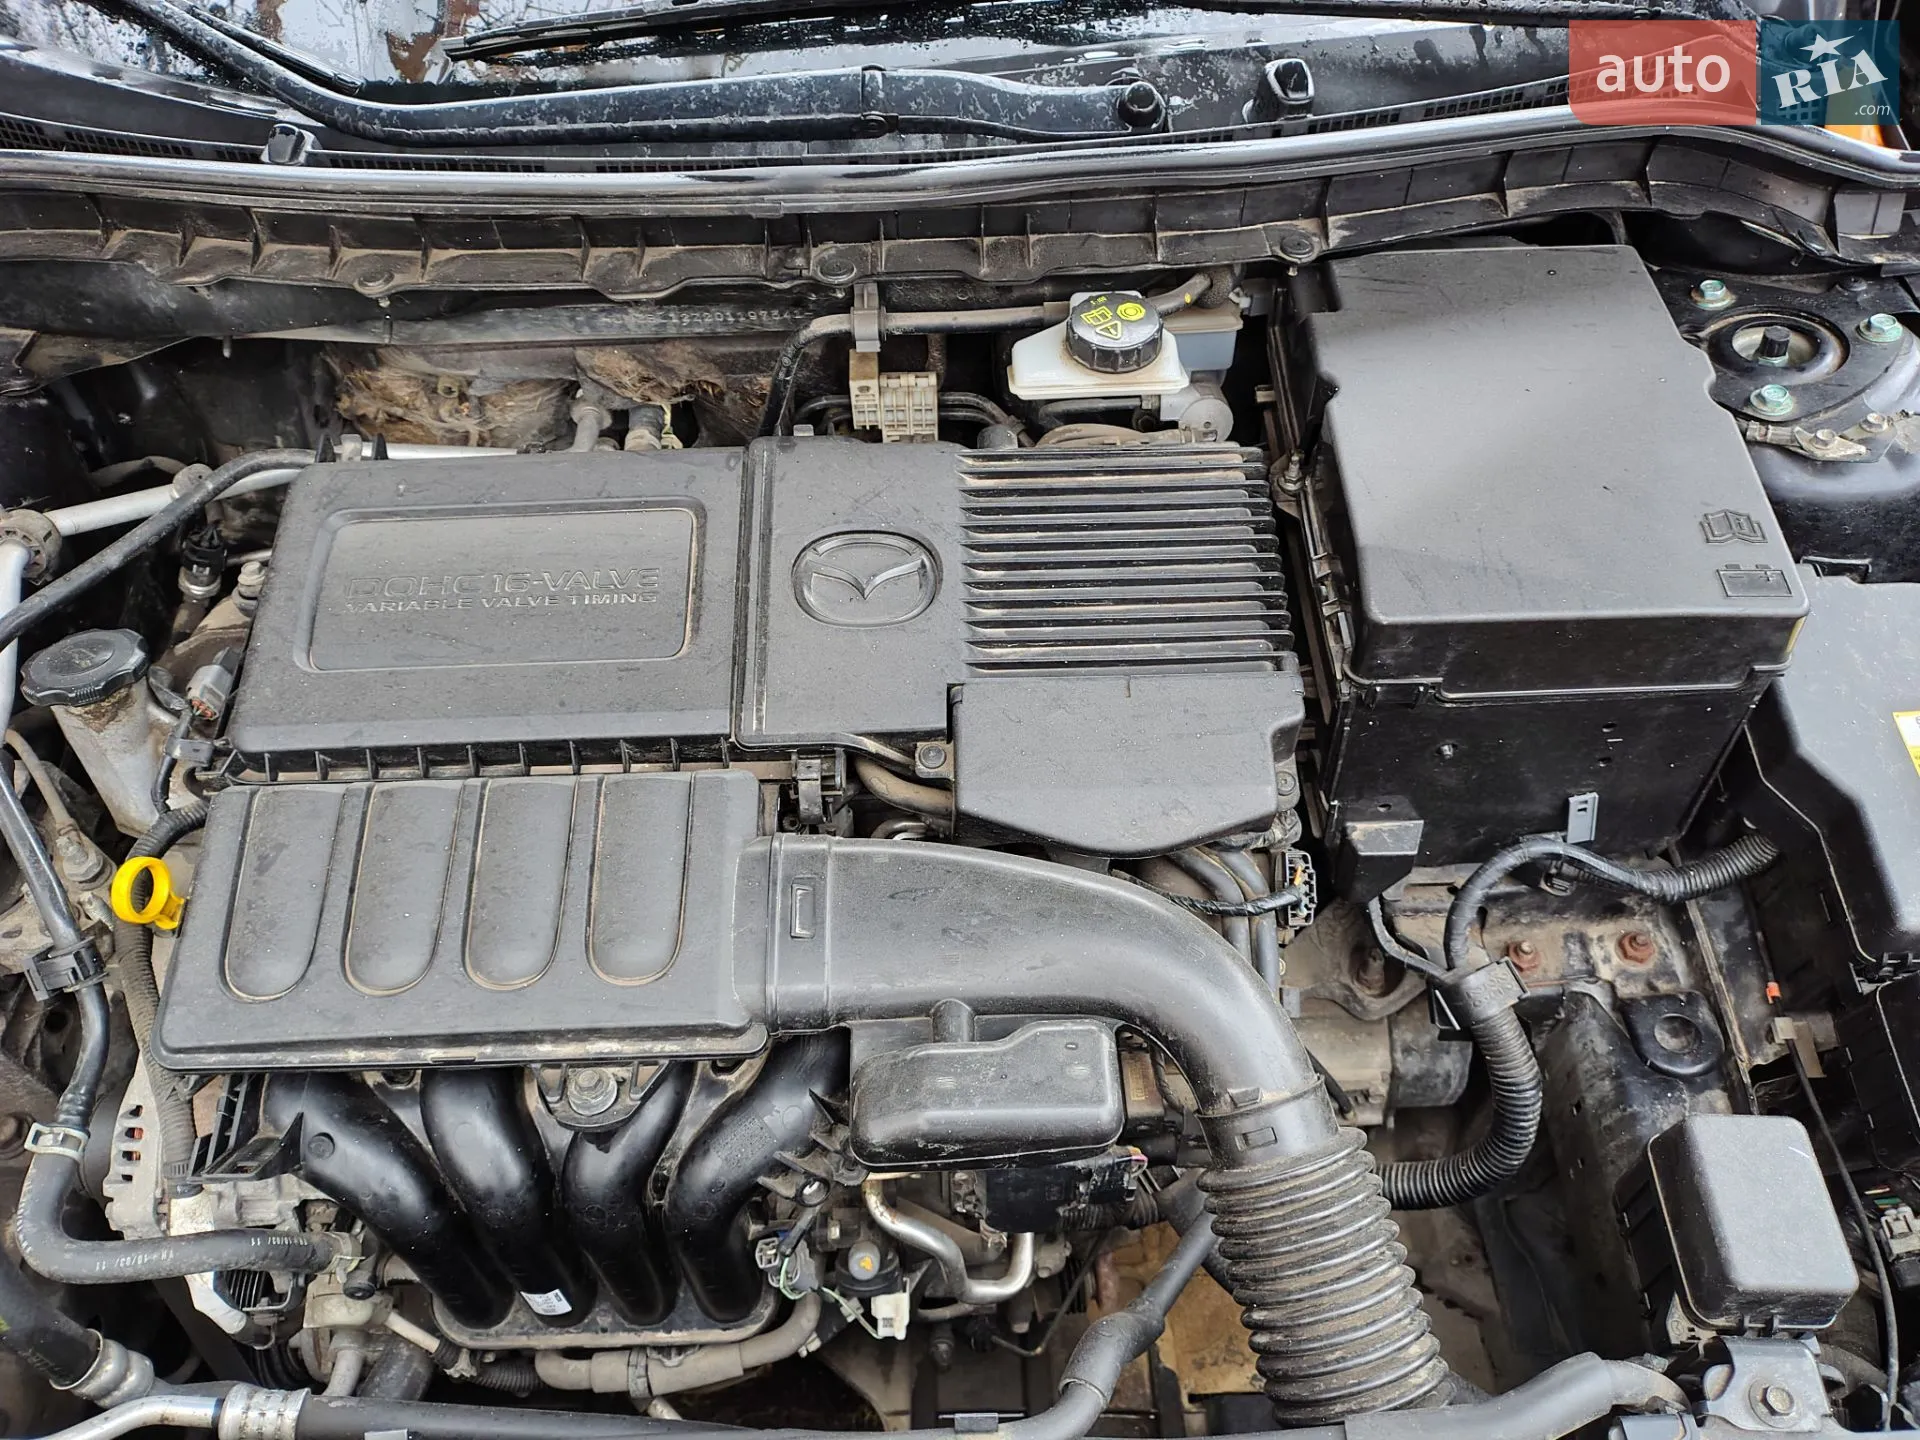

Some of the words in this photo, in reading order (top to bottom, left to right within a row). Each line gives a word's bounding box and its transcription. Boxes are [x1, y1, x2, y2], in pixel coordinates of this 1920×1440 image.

[346, 576, 485, 599] DOHC
[493, 568, 660, 593] 16-VALVE
[345, 598, 473, 612] VARIABLE
[481, 596, 559, 608] VALVE
[568, 591, 658, 605] TIMING
